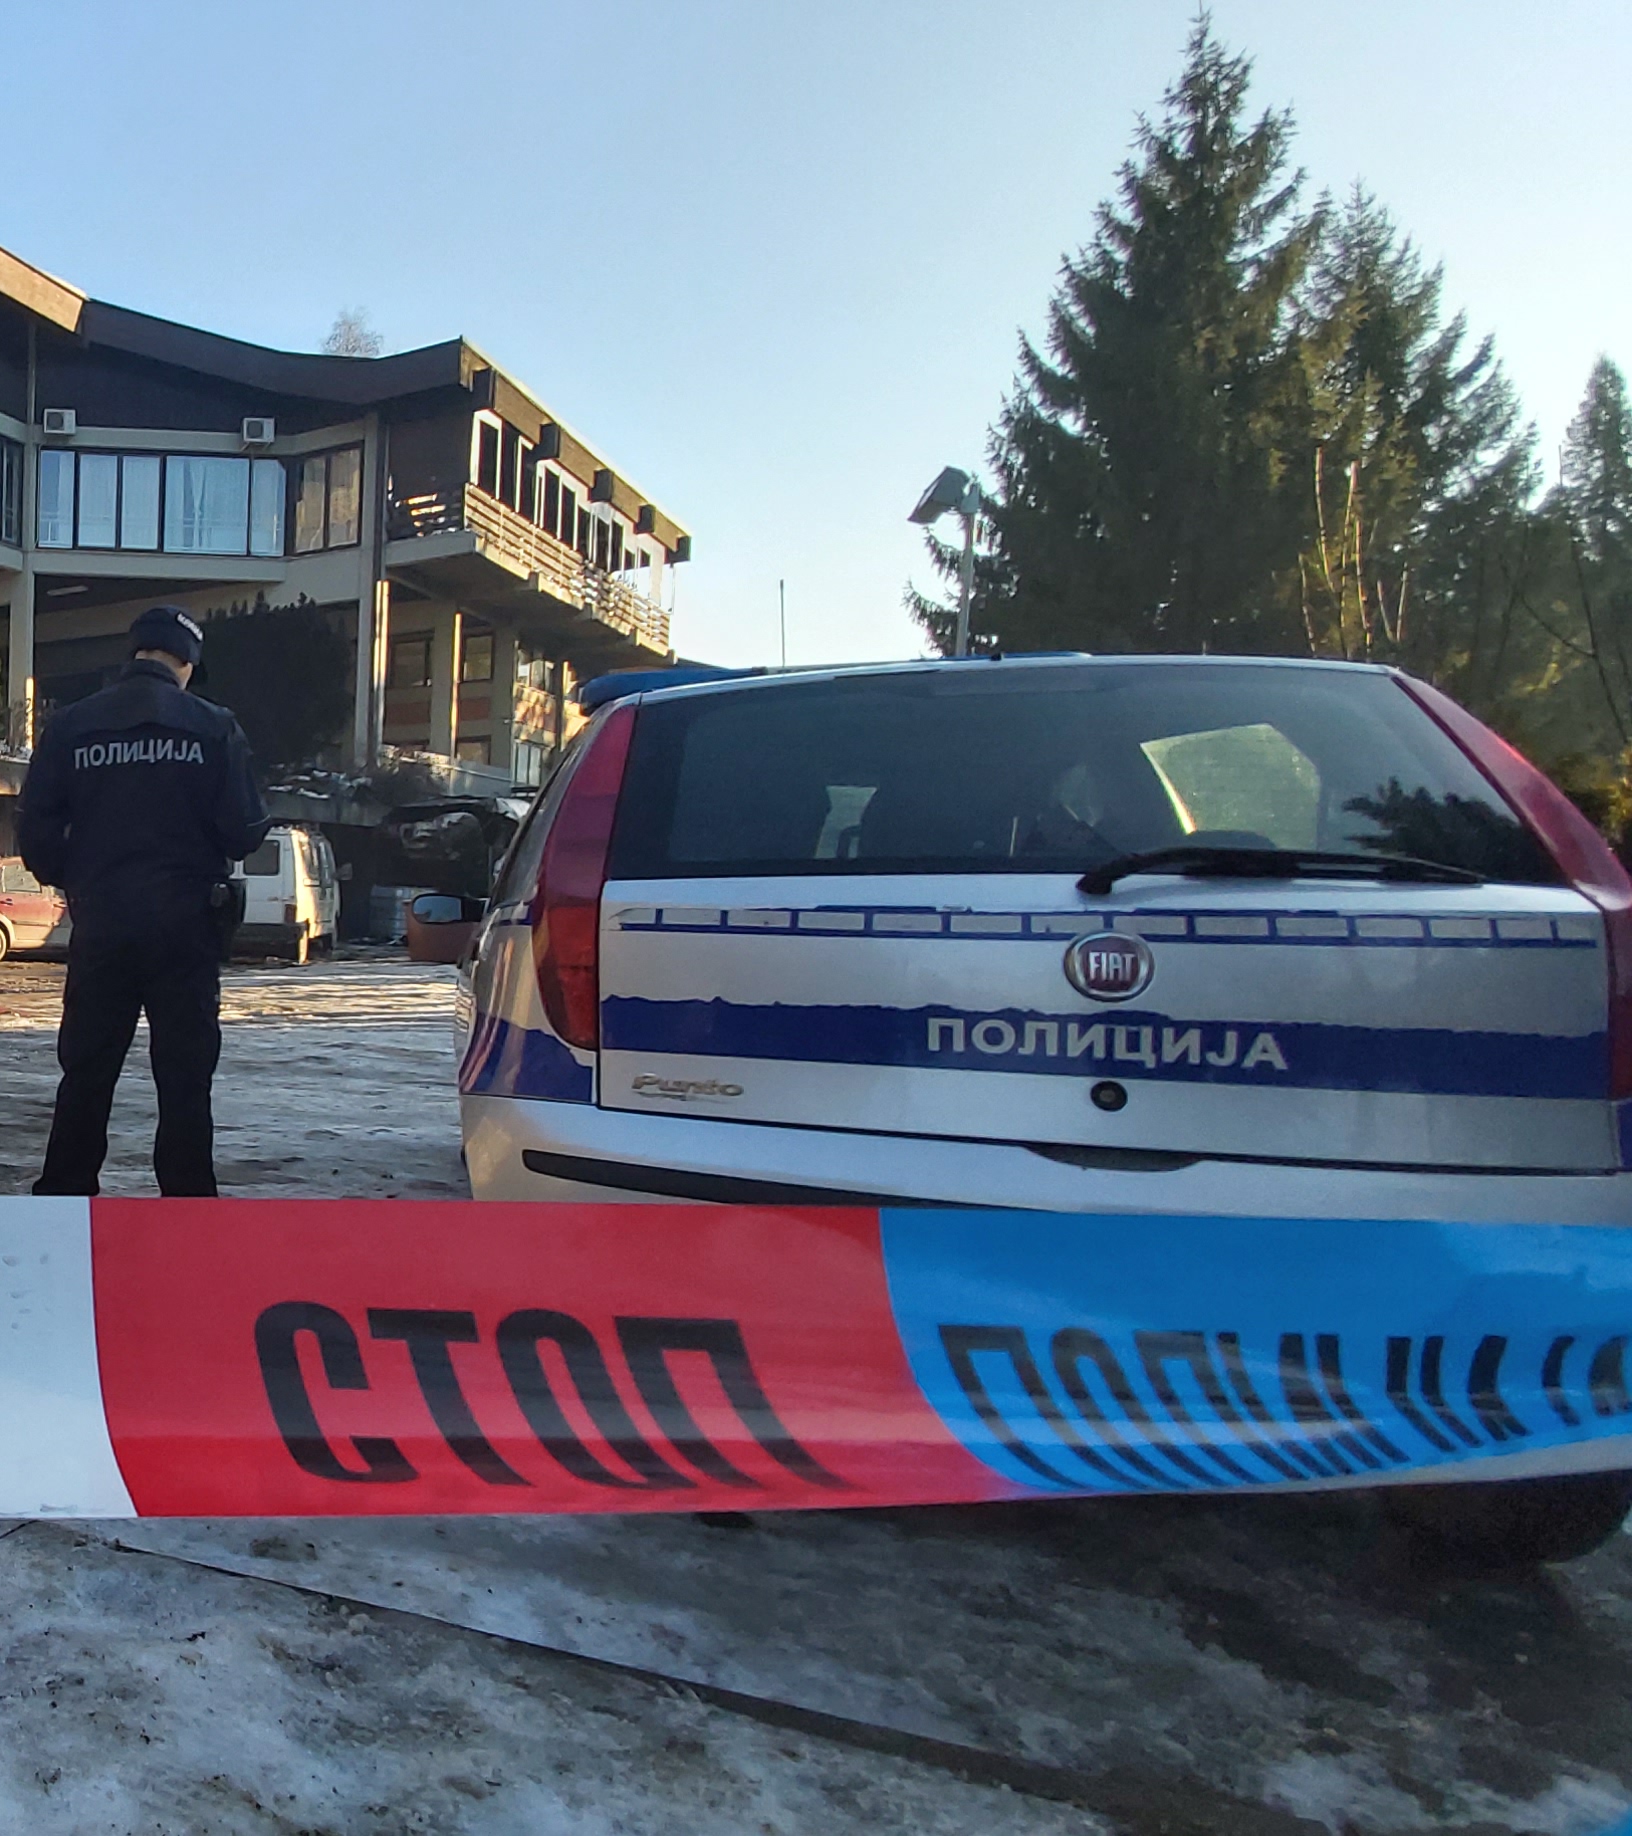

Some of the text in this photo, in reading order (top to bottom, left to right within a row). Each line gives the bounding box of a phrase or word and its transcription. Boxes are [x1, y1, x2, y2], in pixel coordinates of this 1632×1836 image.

[74, 738, 204, 770] ПОЛИЦИЈА
[1088, 951, 1136, 981] FIAT
[927, 1017, 1289, 1070] ПОЛИЦИЈА
[631, 1074, 744, 1097] Punto
[254, 1300, 860, 1492] СТОП
